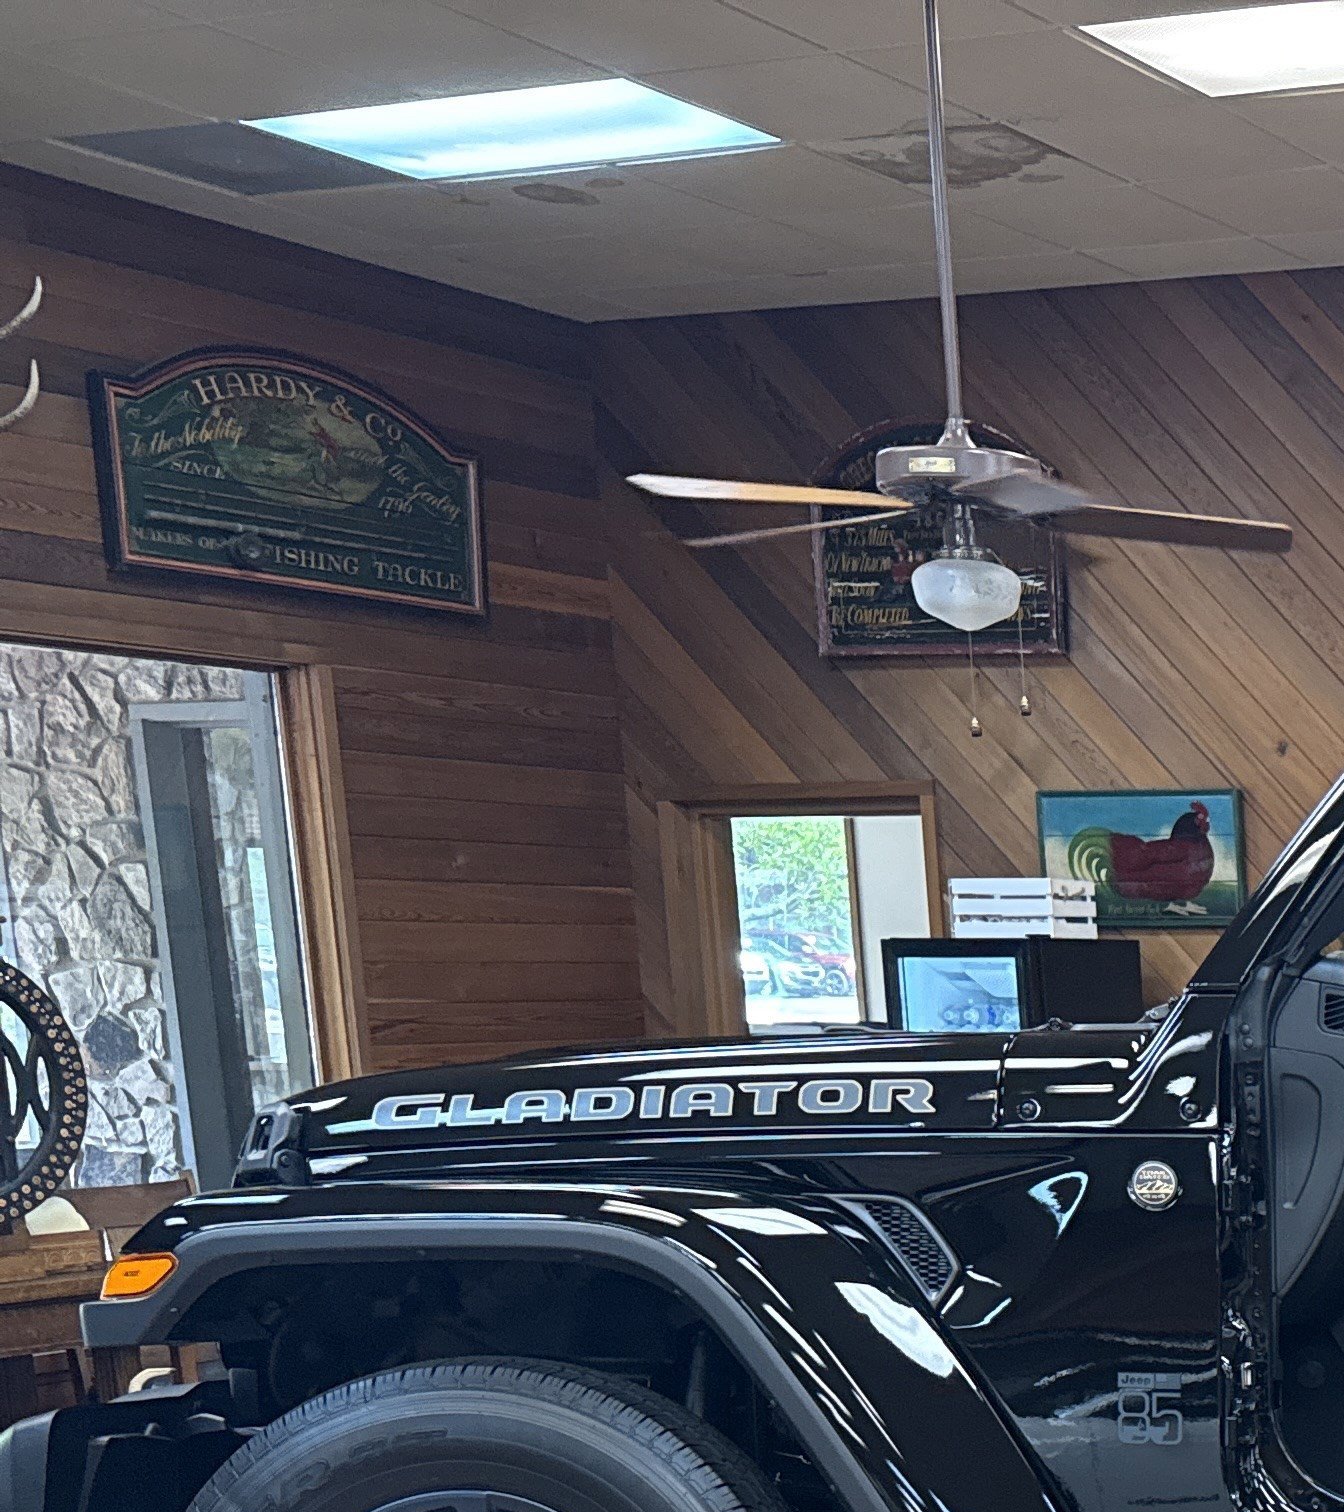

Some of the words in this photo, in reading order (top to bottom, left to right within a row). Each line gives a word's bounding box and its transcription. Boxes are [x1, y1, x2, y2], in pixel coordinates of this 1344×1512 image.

[192, 371, 323, 406] HARDY
[330, 394, 356, 423] &
[170, 460, 226, 480] SINCE
[374, 559, 464, 592] TACKLE
[371, 1078, 936, 1128] GLADIATOR
[1120, 1374, 1152, 1386] Jeep
[1117, 1389, 1184, 1446] 85
